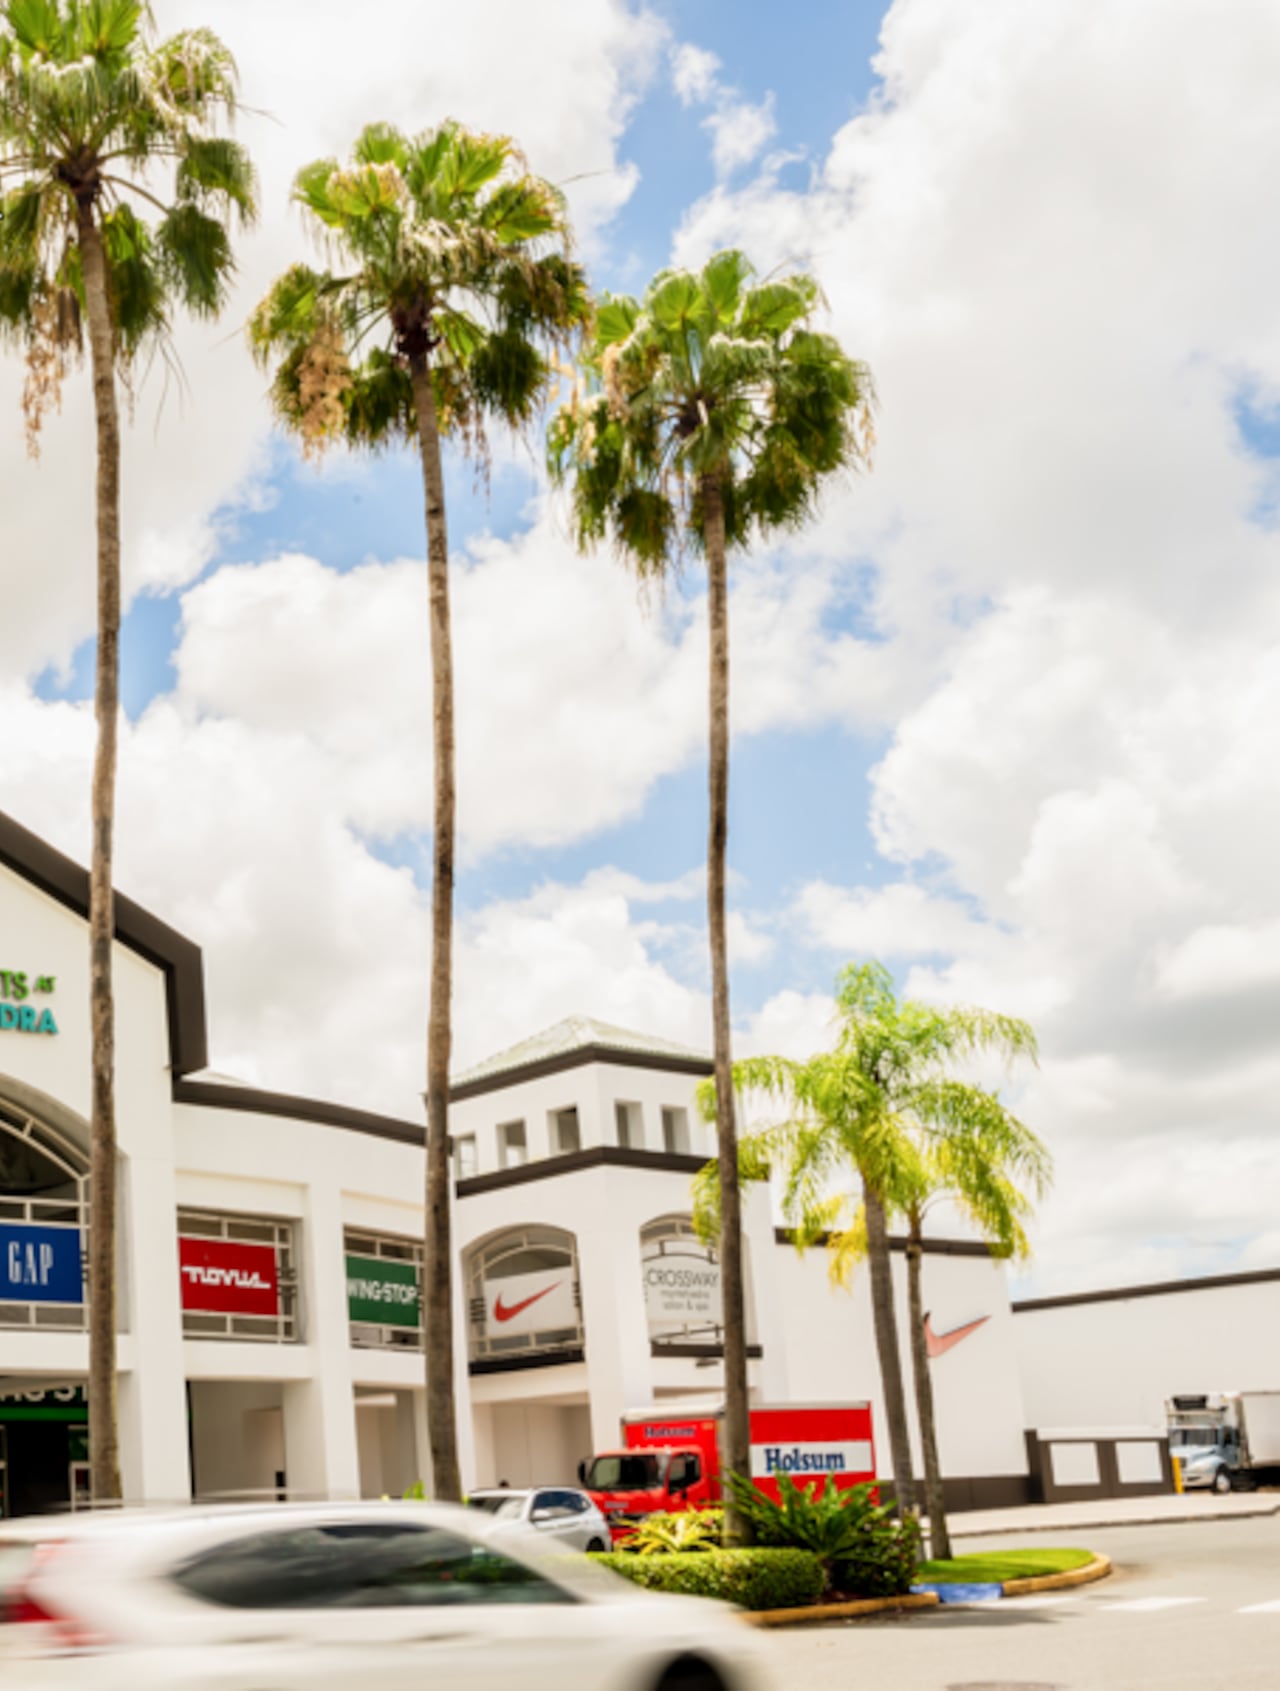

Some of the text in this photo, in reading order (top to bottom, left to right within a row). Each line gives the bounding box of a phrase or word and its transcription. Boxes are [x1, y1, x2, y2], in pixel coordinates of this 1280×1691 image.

[34, 975, 56, 993] AT
[8, 1241, 54, 1286] GAP
[647, 1267, 719, 1288] CROSSWAY
[764, 1448, 846, 1473] Holsum
